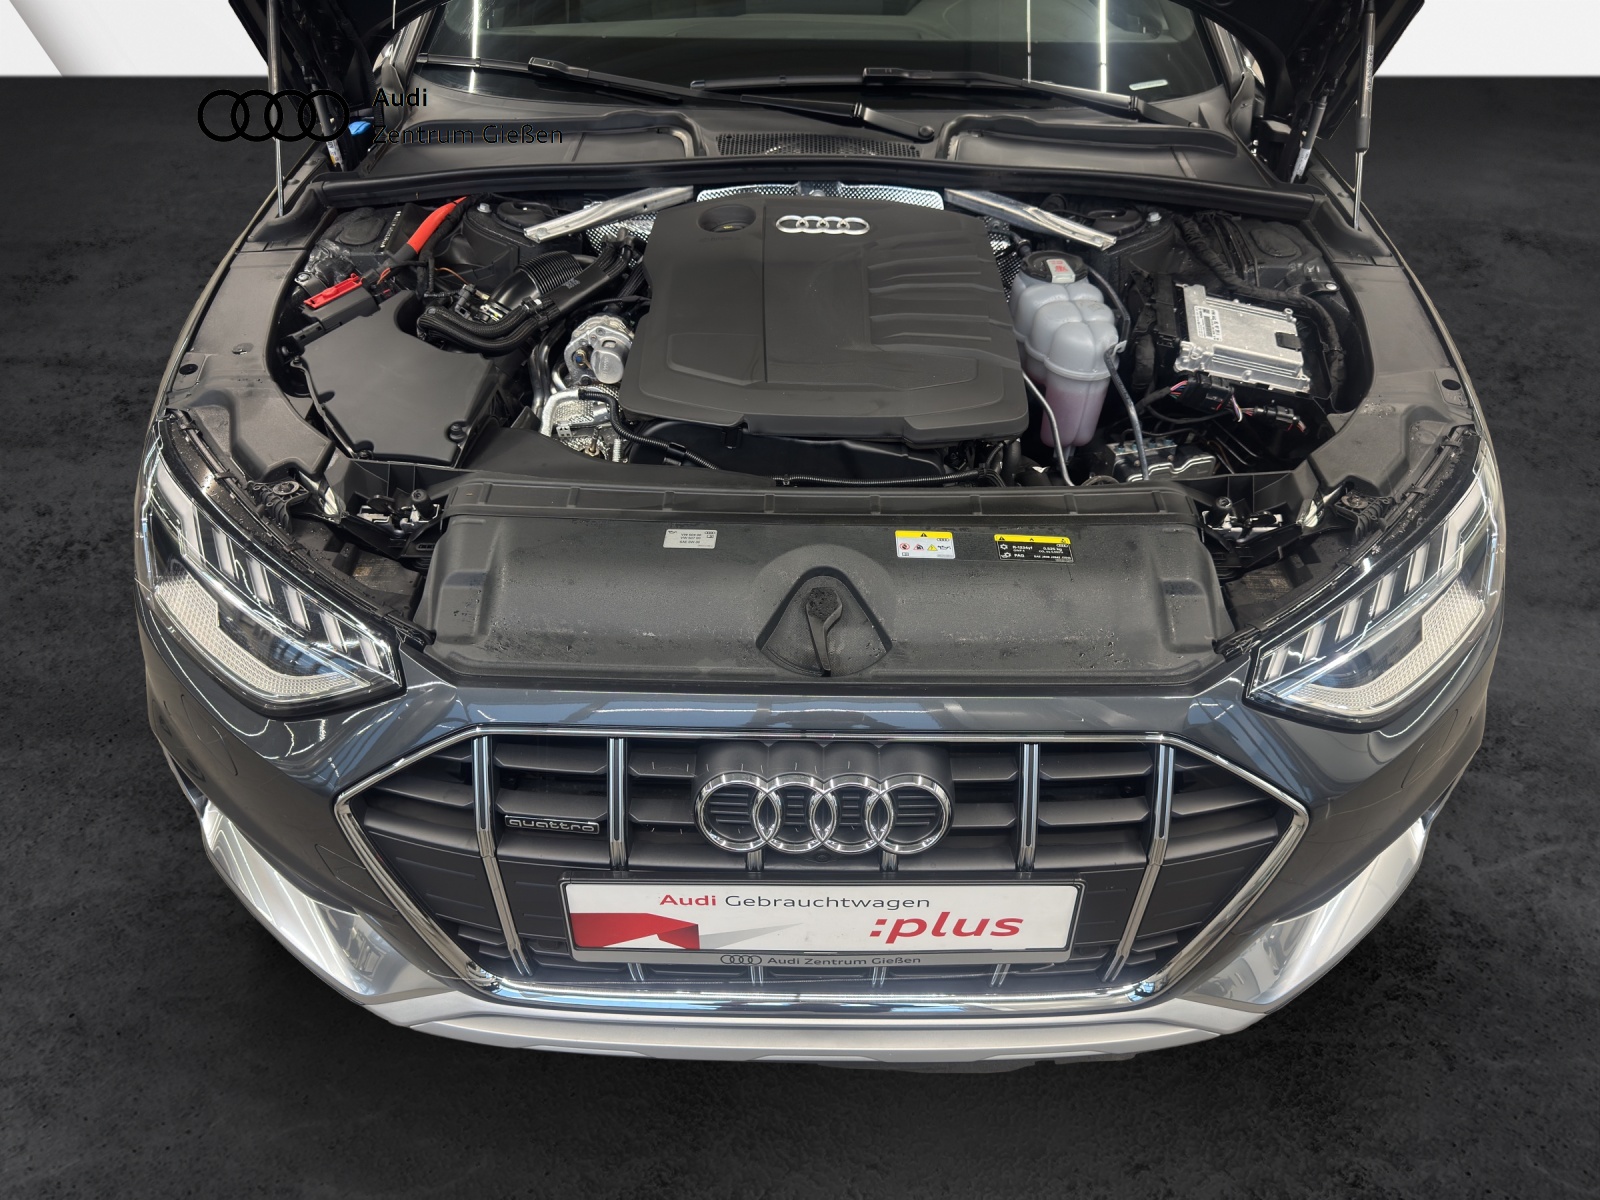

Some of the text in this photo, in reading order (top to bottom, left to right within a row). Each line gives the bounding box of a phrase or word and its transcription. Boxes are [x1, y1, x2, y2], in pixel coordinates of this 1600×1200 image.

[508, 818, 595, 832] quattro
[659, 893, 932, 910] Audi Gebrauchtwagen
[766, 955, 922, 967] Audi Zentrum Gießen
